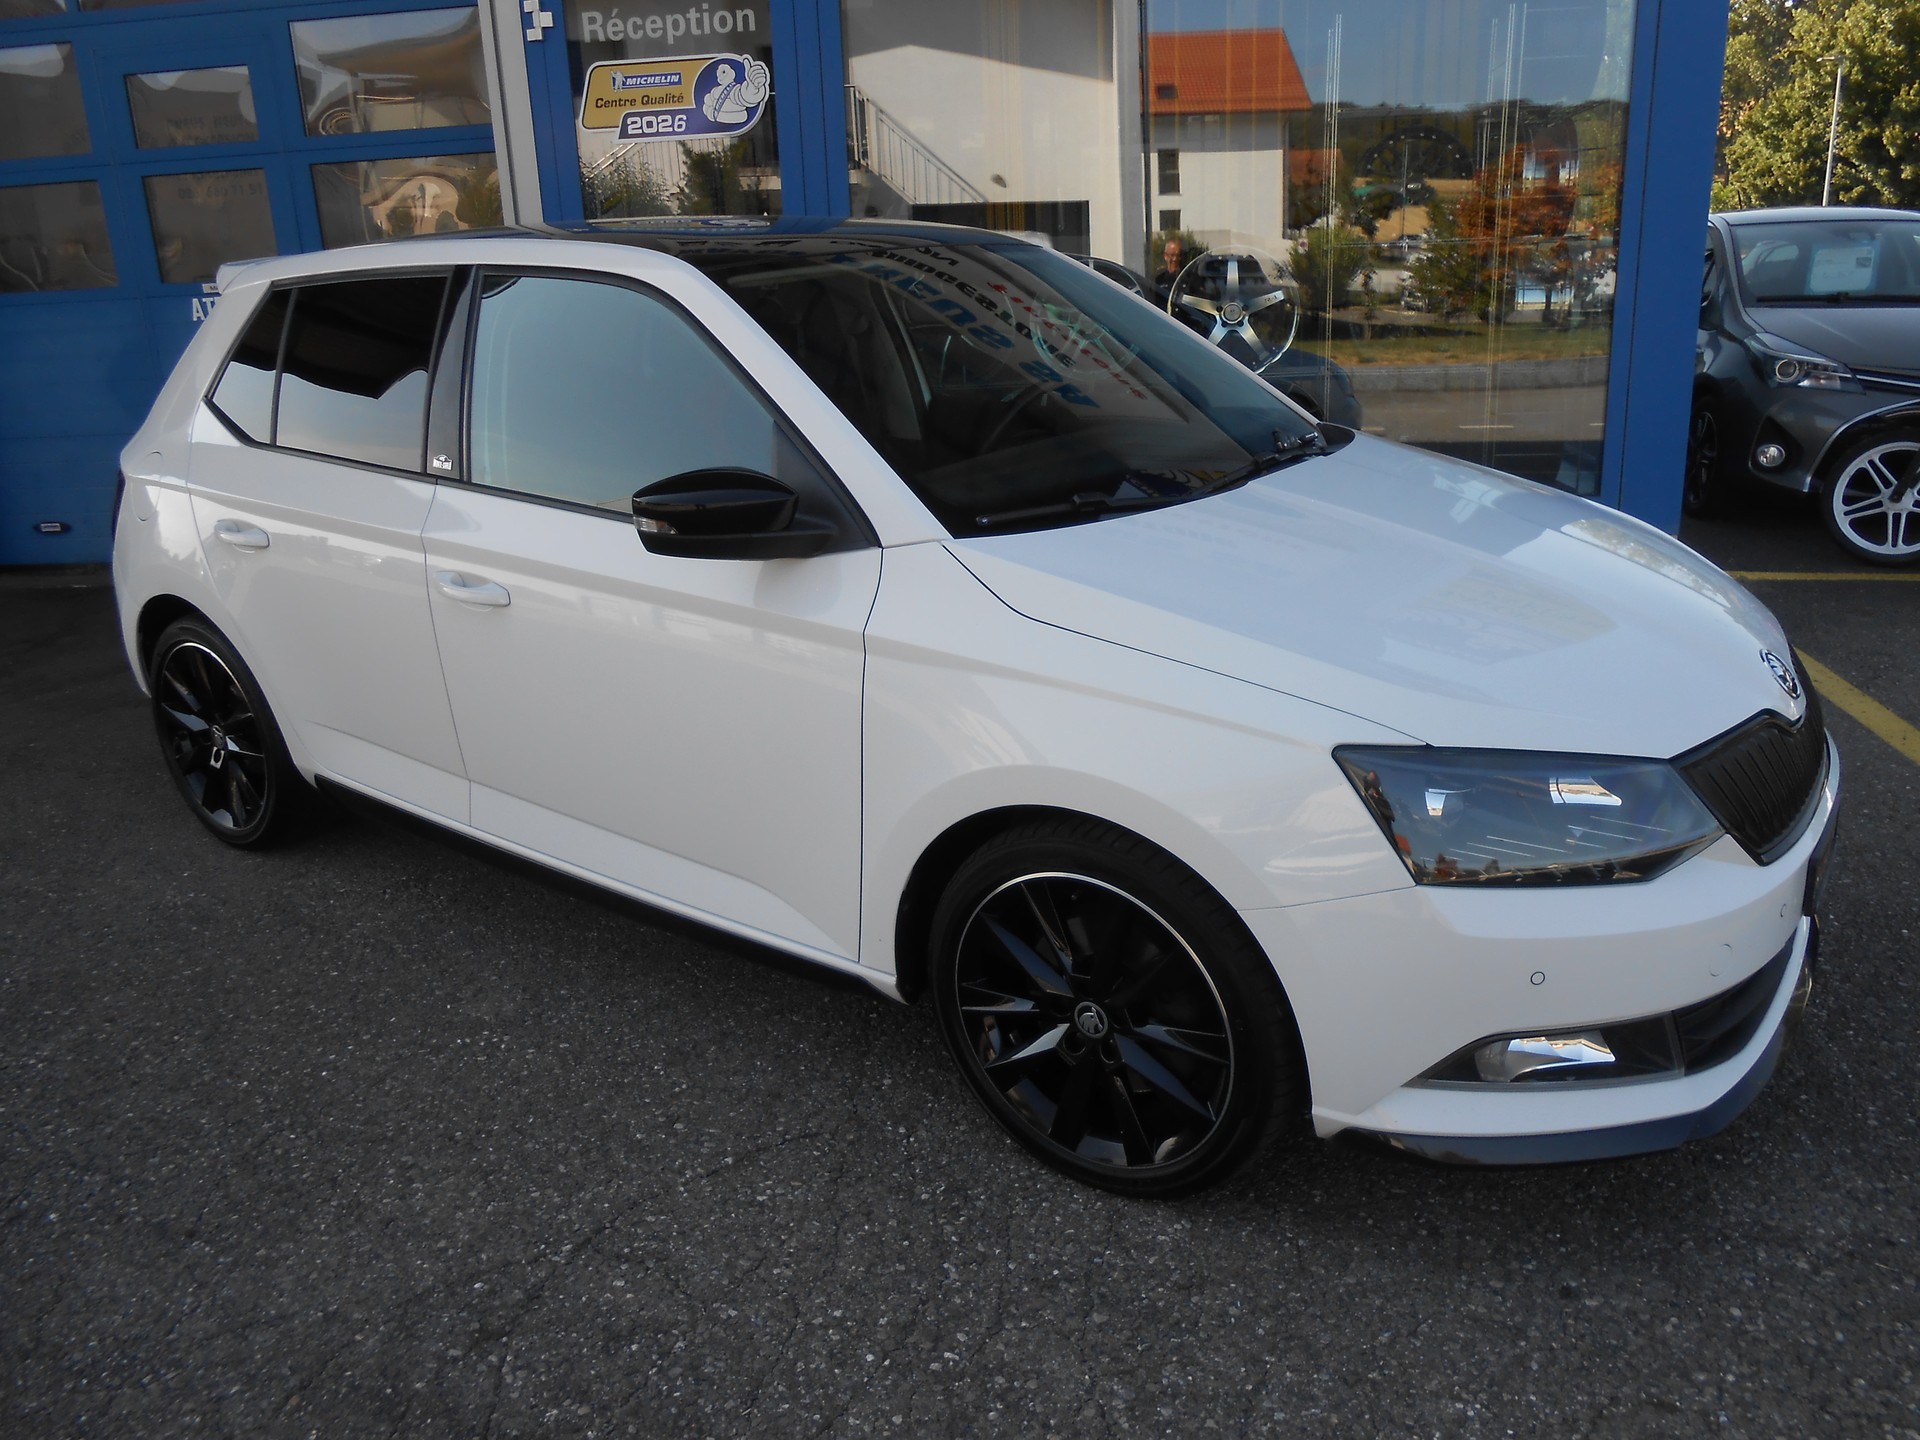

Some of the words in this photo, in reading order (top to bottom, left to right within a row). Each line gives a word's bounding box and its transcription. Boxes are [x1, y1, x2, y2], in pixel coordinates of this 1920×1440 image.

[582, 3, 756, 44] Réception
[626, 74, 680, 85] MICHELIN
[595, 97, 637, 109] Centre
[641, 93, 684, 106] Qualité
[627, 115, 688, 134] 2026
